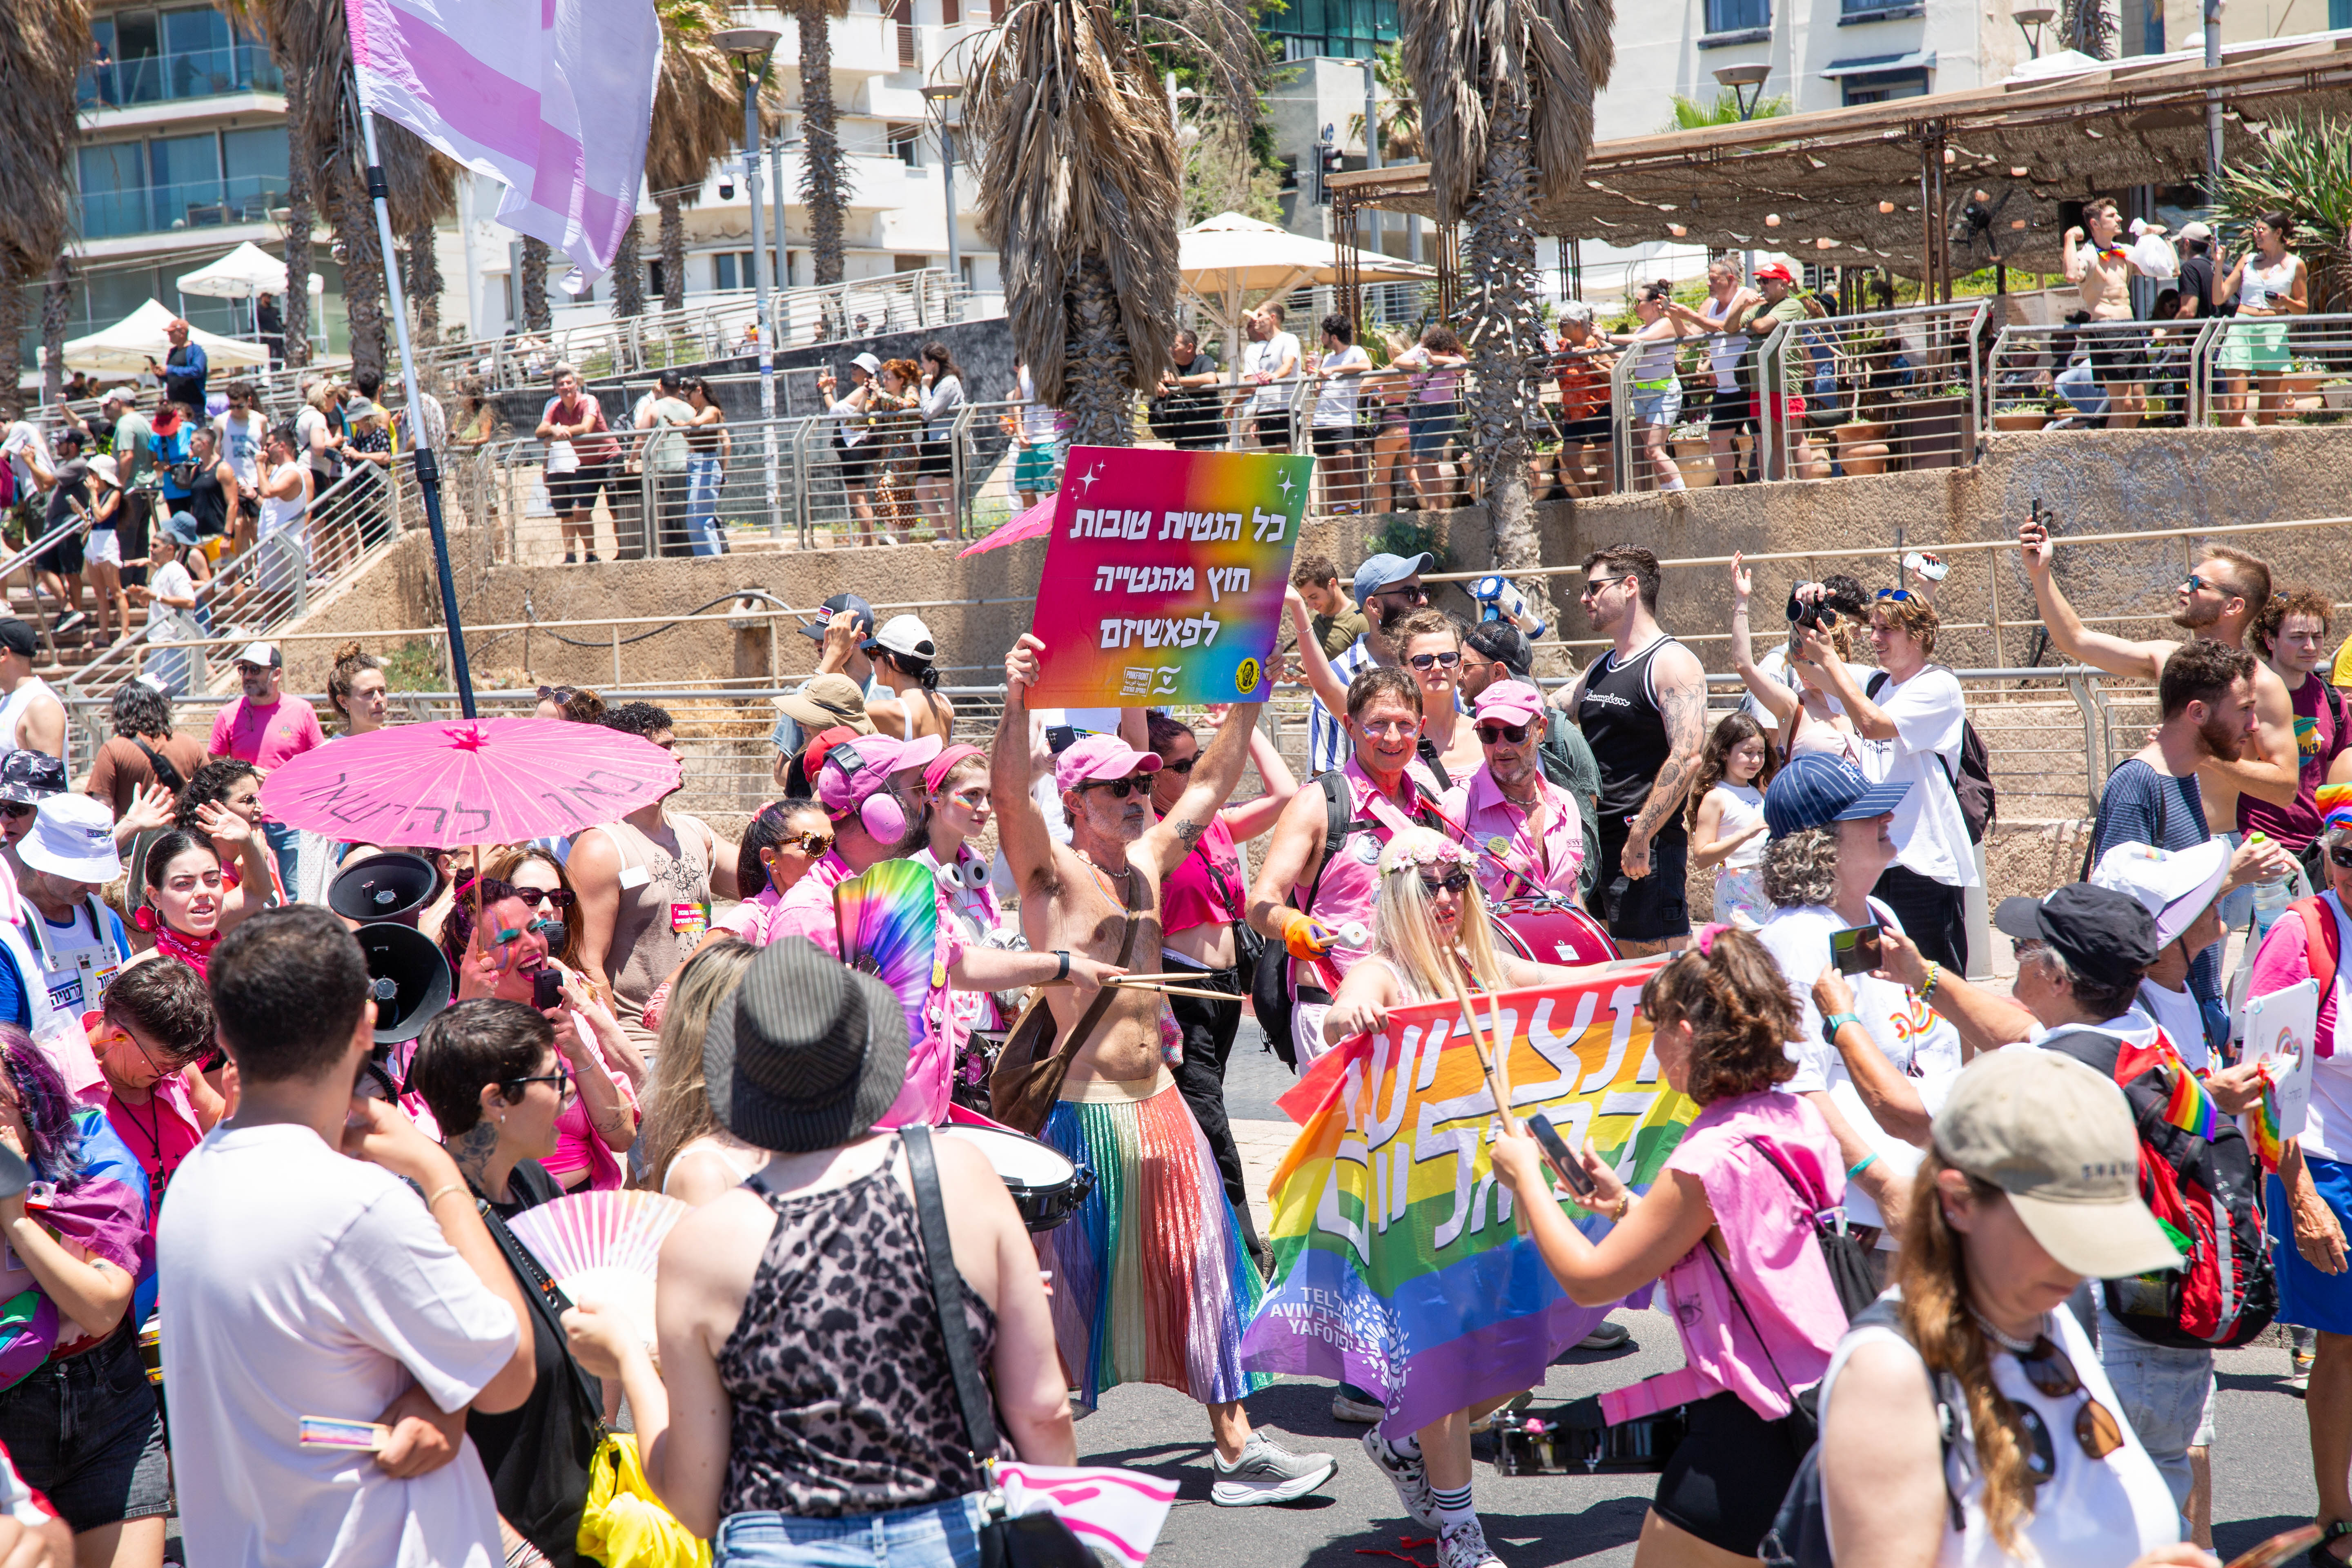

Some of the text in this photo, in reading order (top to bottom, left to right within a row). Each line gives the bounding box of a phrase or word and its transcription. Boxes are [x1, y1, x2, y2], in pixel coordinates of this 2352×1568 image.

[1070, 506, 1287, 542] כל הנטיות טובות
[1094, 566, 1250, 603] חוץ מהנטייה
[1100, 612, 1220, 648] לפאשיזם
[1126, 670, 1149, 681] PINKFRONT
[1581, 688, 1631, 708] Champion
[299, 769, 644, 835] כאן להישאר
[49, 982, 82, 1006] קרטיה
[1301, 1287, 1334, 1307] TEL
[1270, 1303, 1314, 1319] AVIV
[1288, 1319, 1333, 1343] YAFO
